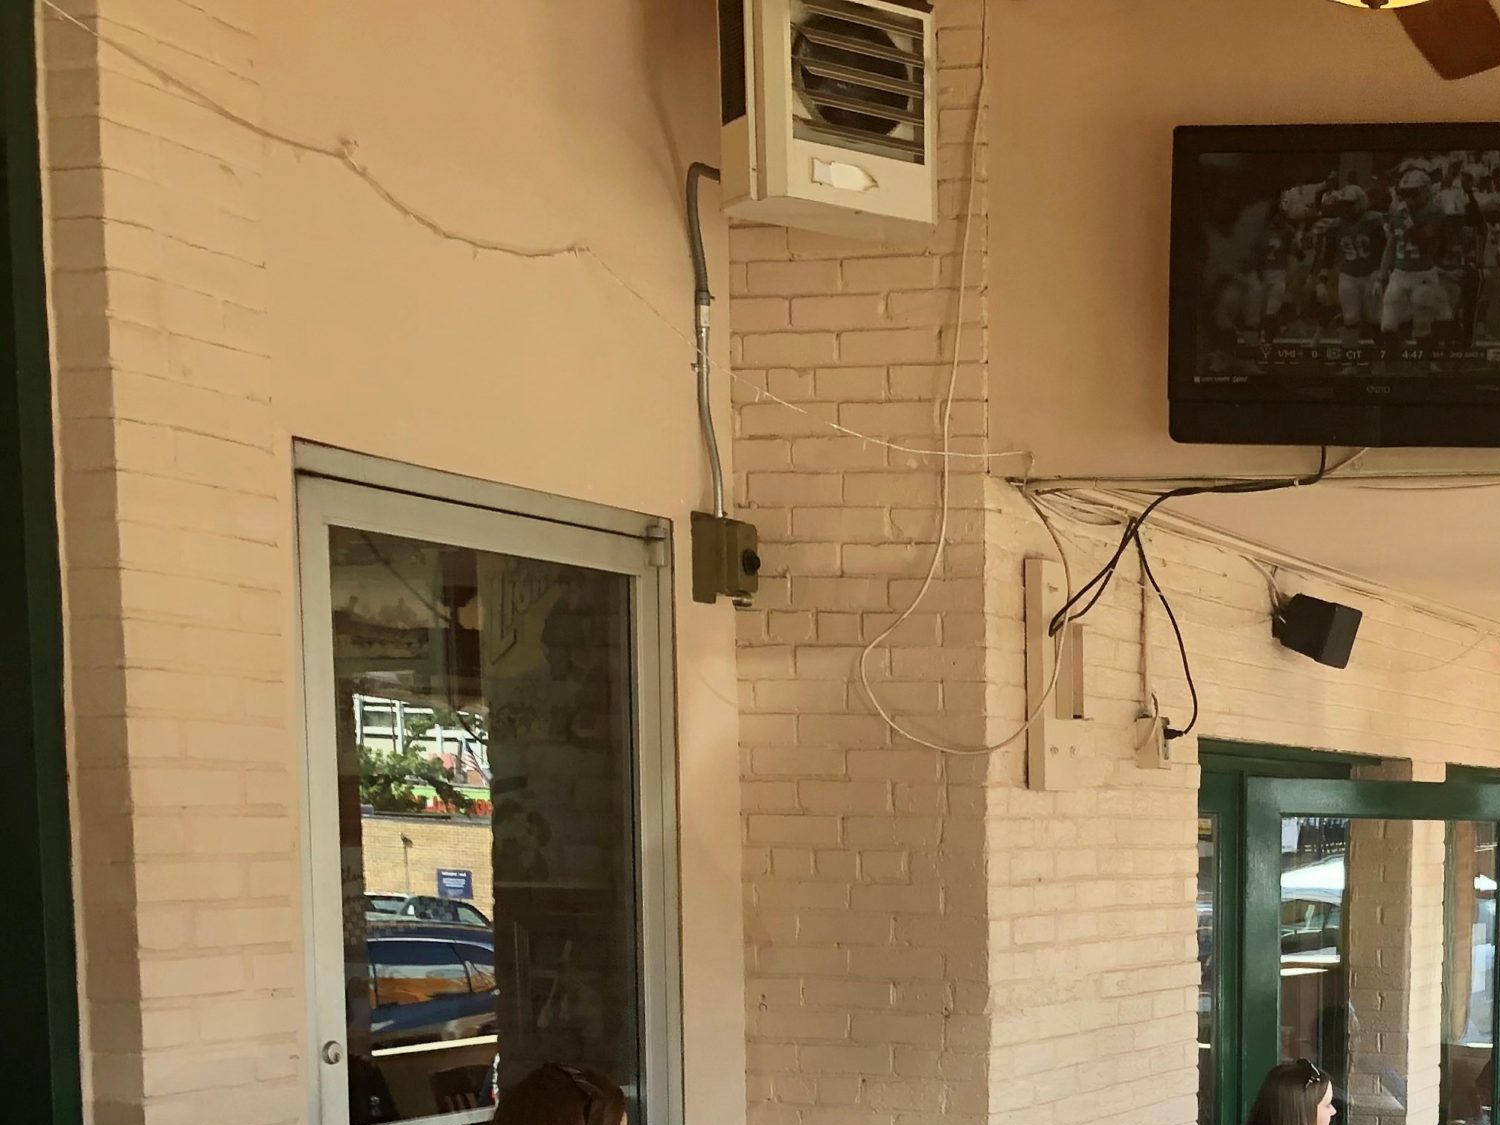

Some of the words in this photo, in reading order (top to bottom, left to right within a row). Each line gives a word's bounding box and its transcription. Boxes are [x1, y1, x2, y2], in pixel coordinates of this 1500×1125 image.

[1277, 349, 1296, 359] VMI
[1345, 349, 1362, 360] CIT
[1379, 350, 1387, 360] 7
[1401, 349, 1424, 360] 4:47
